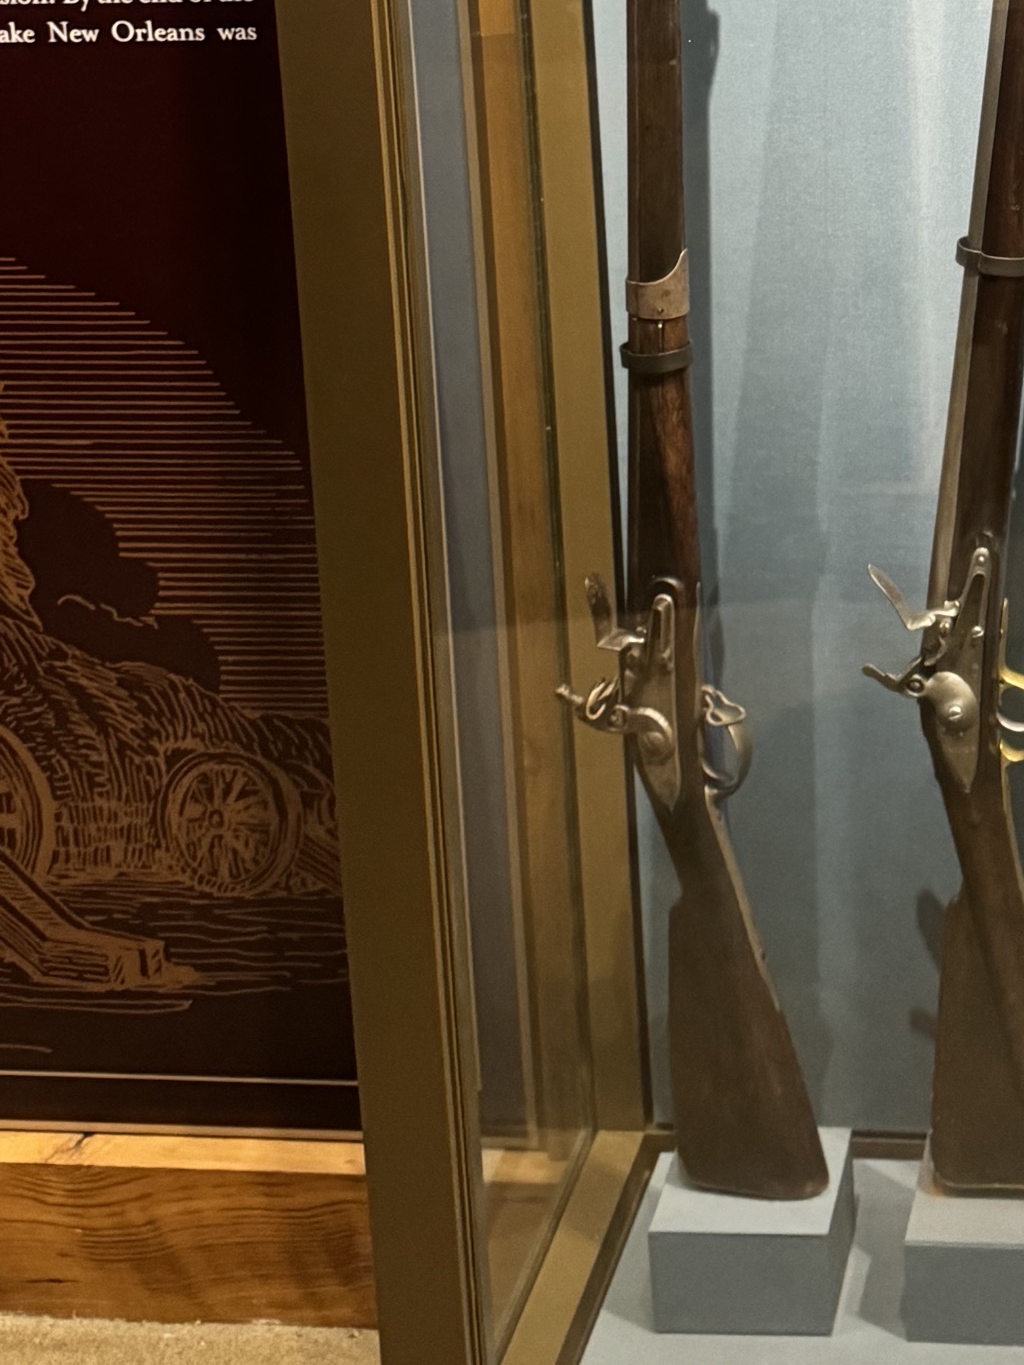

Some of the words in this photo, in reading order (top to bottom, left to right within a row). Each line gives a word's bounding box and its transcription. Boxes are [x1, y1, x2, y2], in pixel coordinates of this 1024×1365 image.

[47, 21, 100, 43] New
[111, 20, 206, 42] Orleans
[217, 26, 257, 41] was
